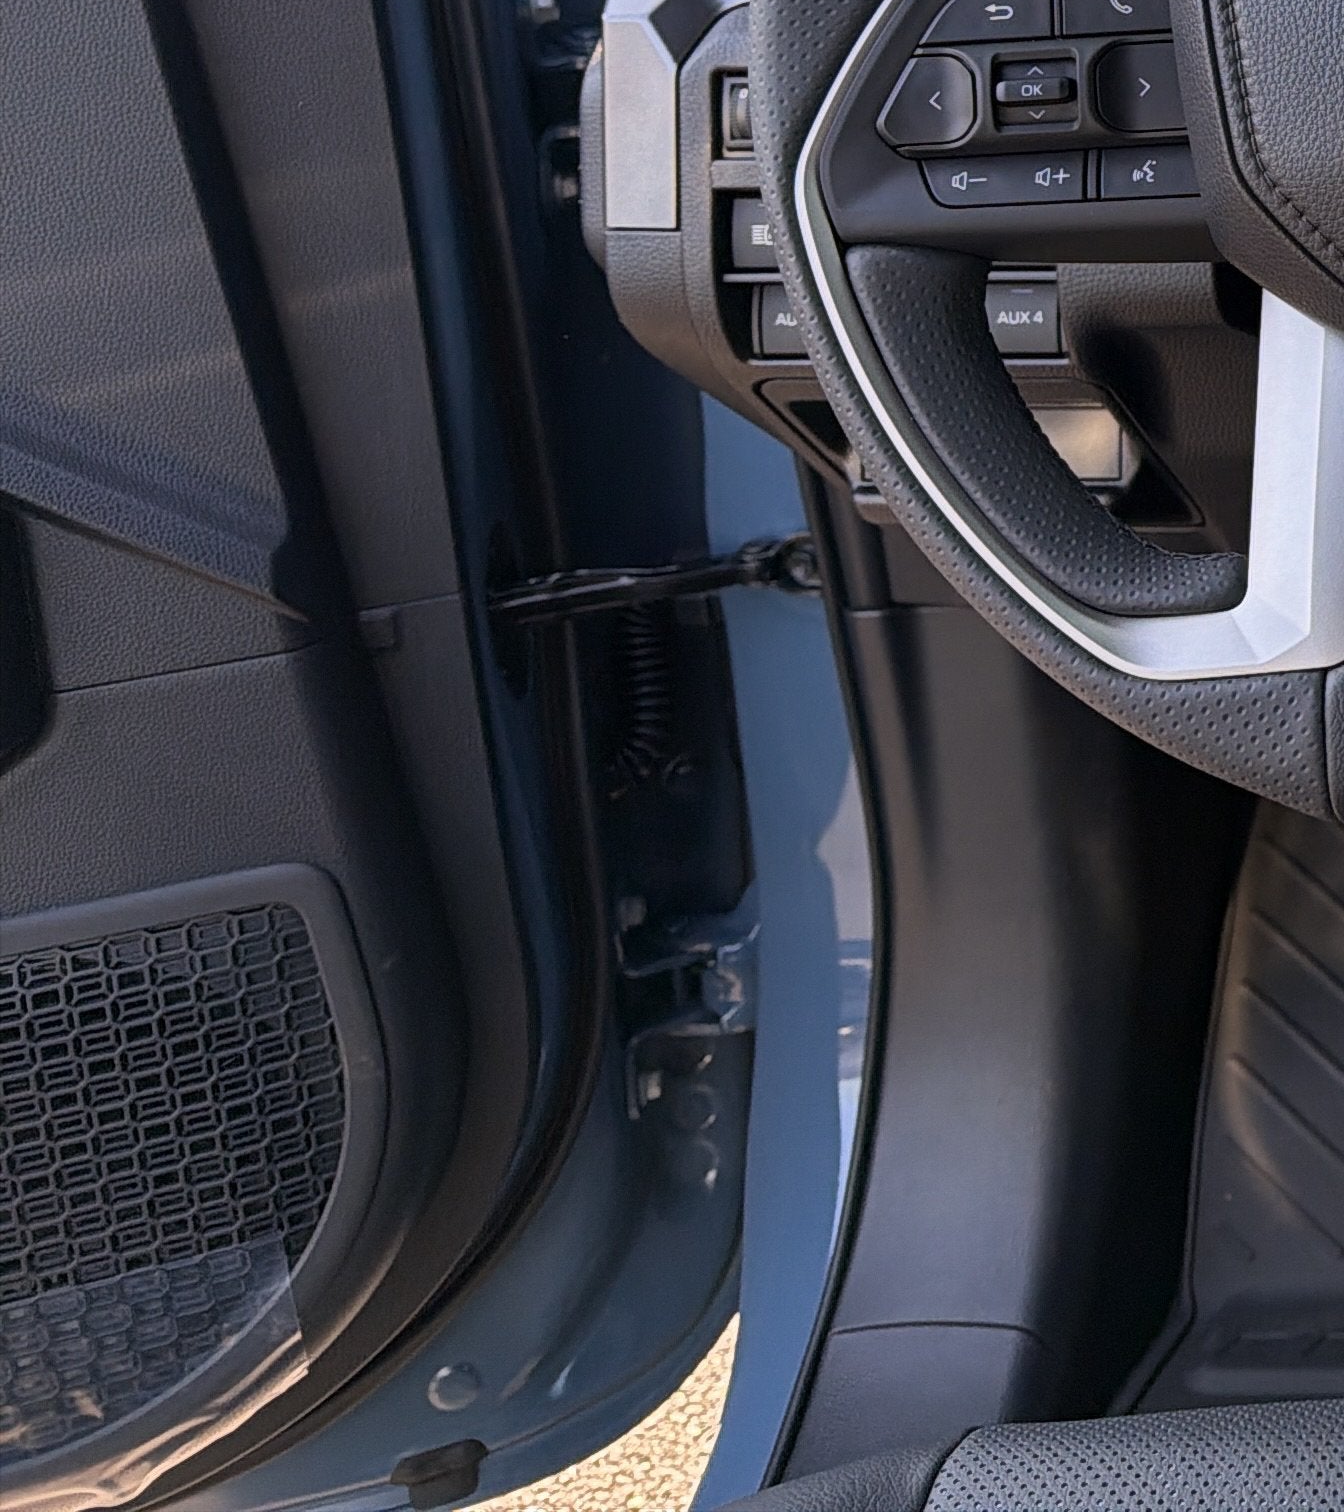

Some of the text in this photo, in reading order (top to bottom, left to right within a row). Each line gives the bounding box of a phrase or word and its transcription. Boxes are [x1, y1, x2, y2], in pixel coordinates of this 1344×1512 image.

[1020, 83, 1043, 97] OK
[774, 311, 799, 327] AU
[997, 310, 1044, 325] AUX 4
